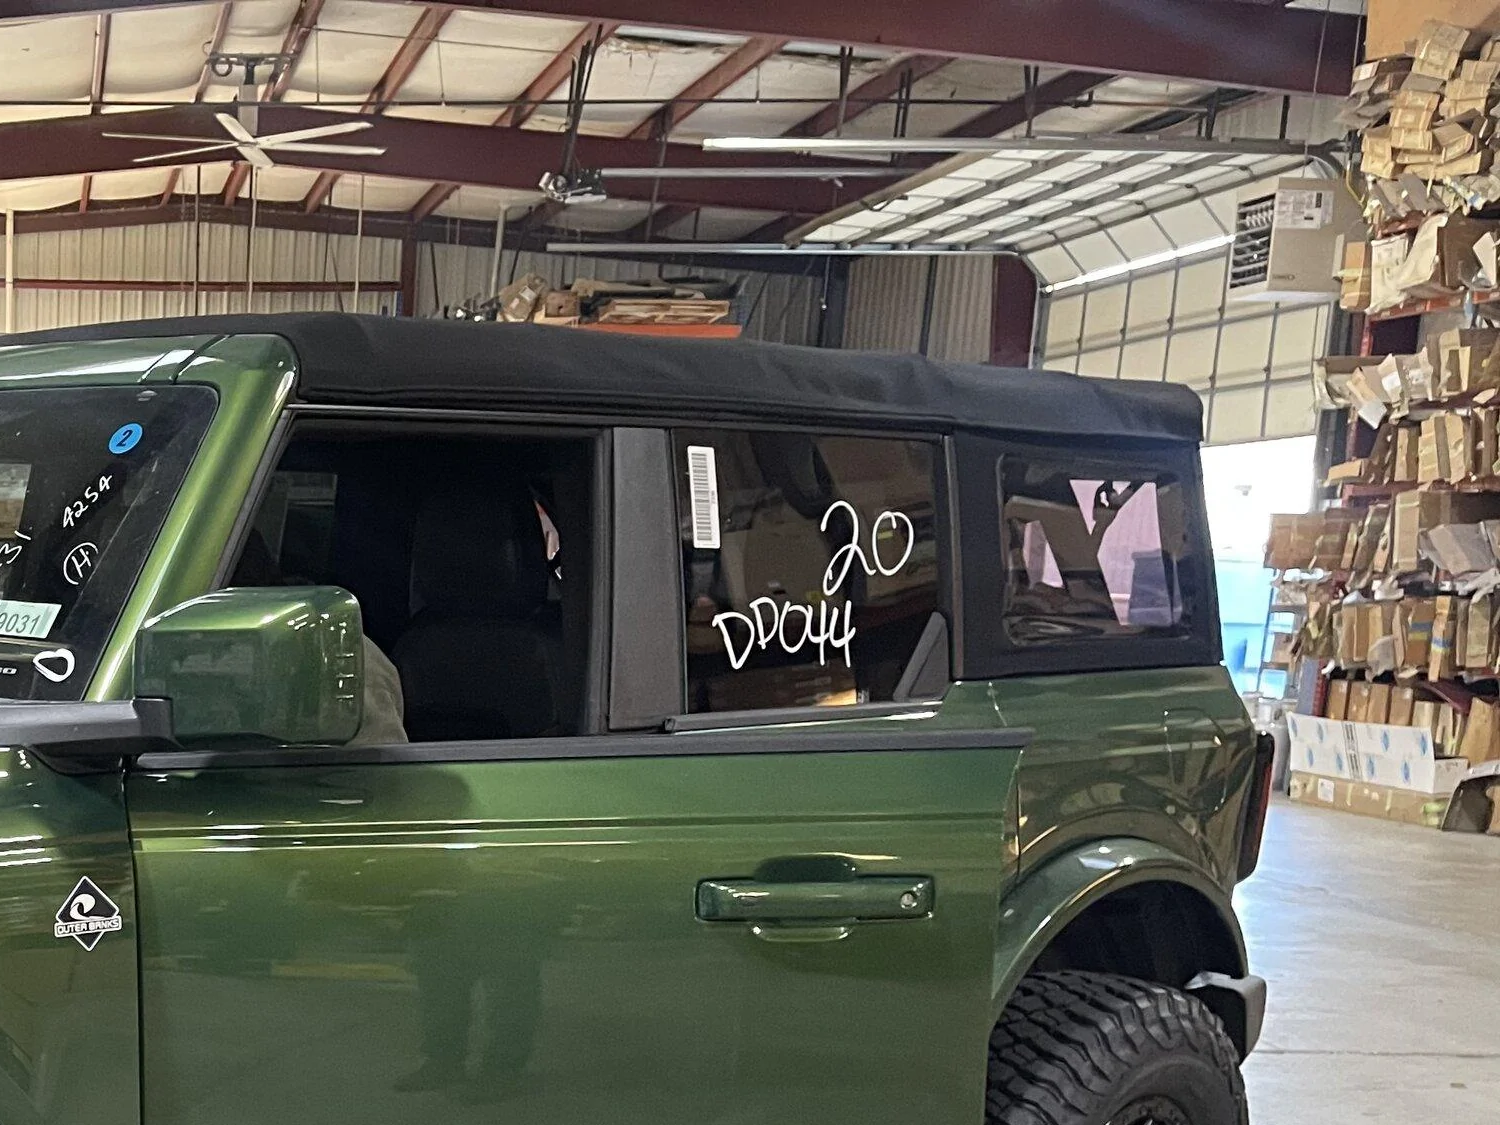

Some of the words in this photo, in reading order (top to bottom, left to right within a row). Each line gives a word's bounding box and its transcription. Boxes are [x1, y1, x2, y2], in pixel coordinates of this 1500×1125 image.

[115, 429, 133, 447] 2
[820, 500, 914, 596] 20
[57, 923, 87, 934] OUTER
[89, 919, 119, 930] BANKS
